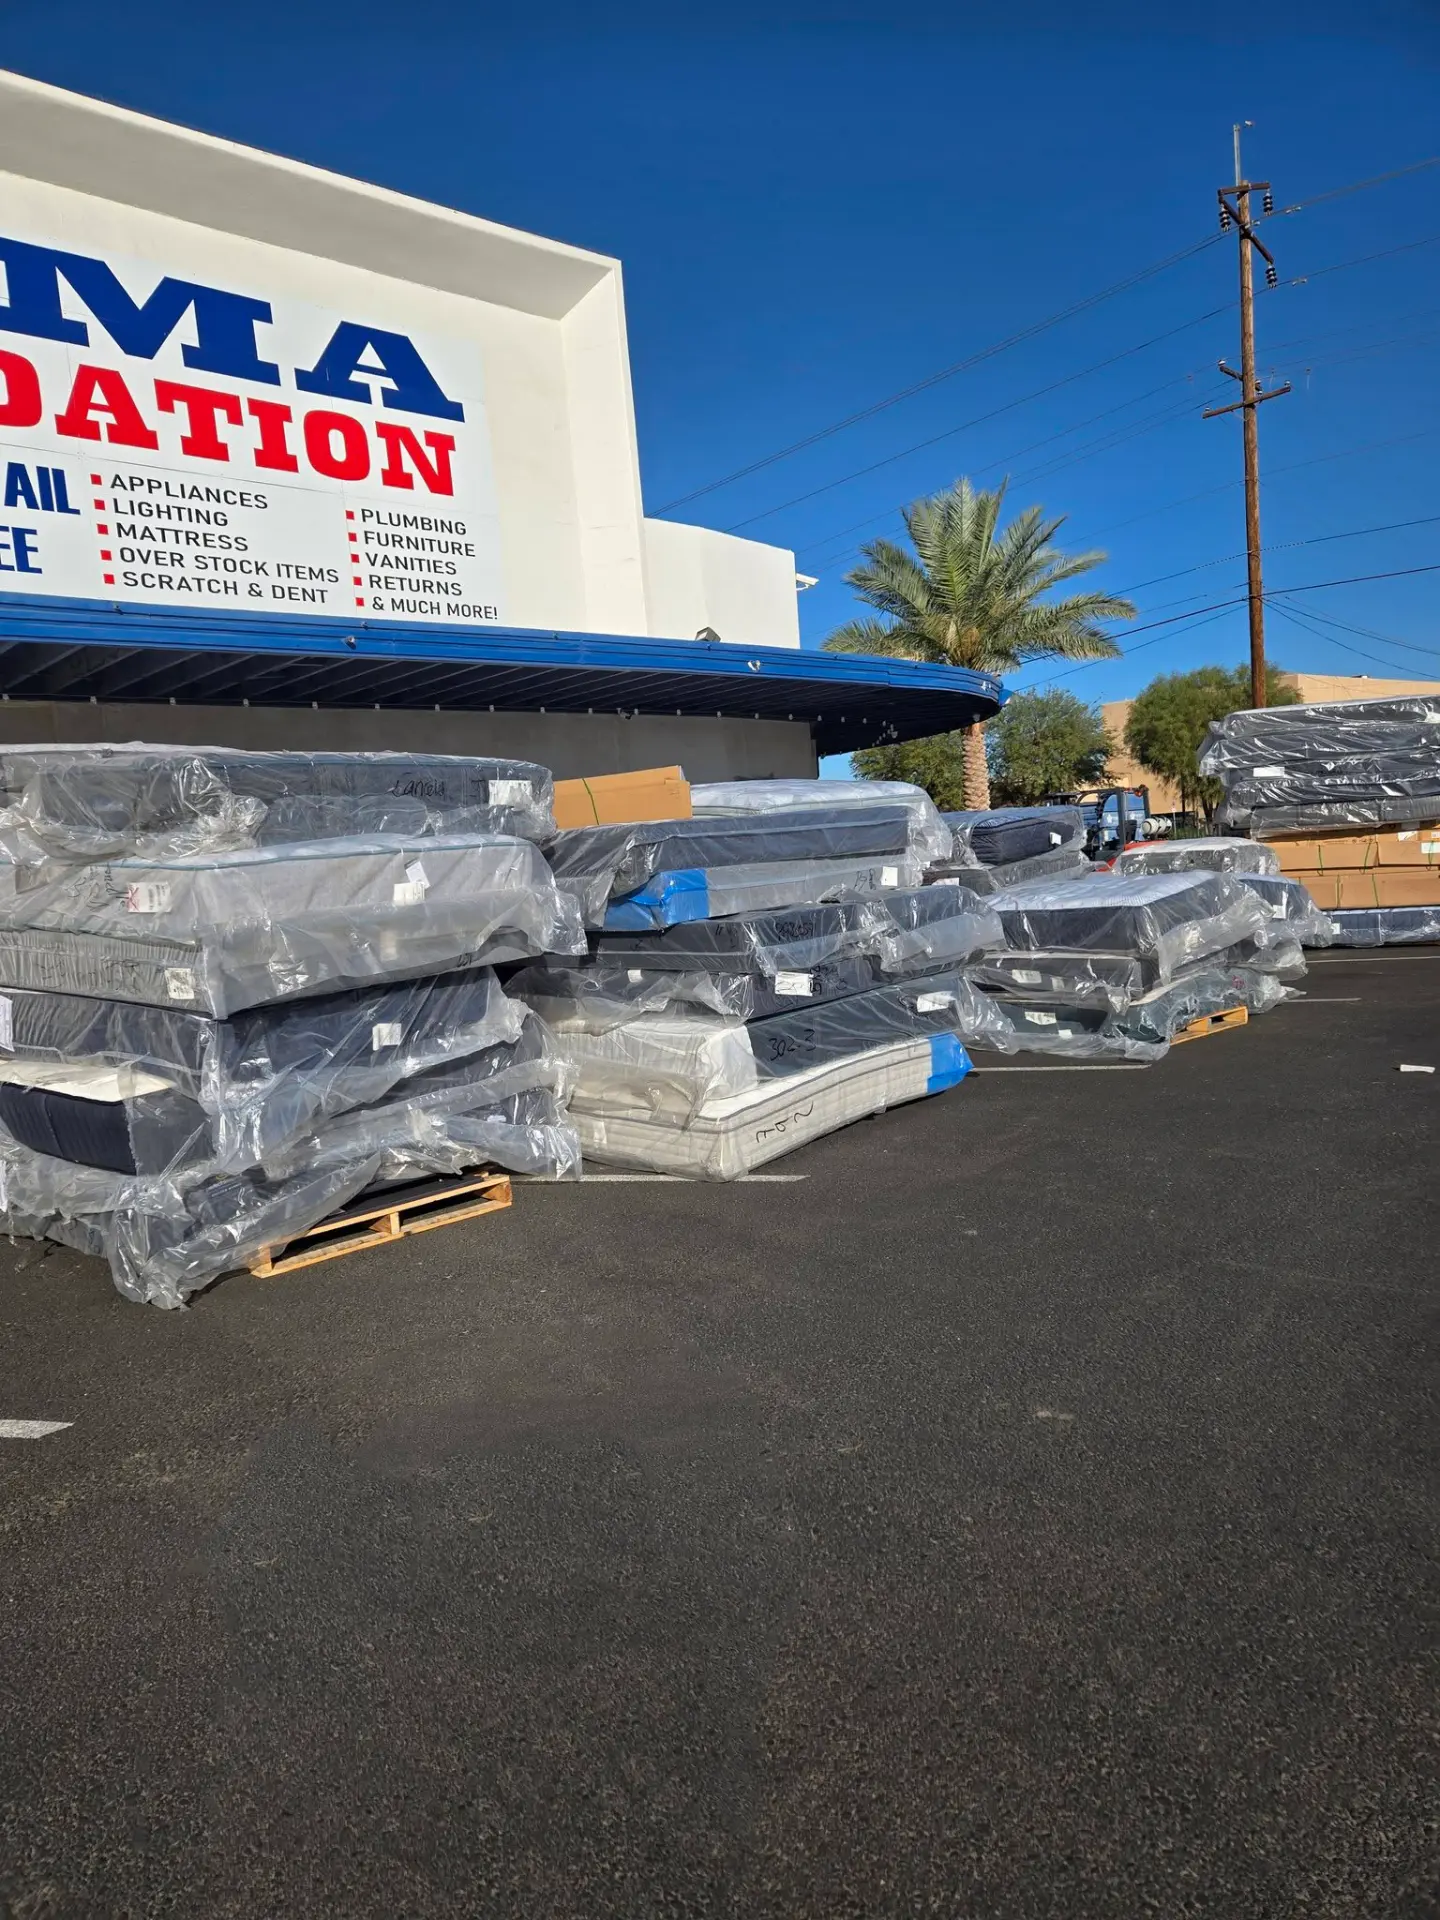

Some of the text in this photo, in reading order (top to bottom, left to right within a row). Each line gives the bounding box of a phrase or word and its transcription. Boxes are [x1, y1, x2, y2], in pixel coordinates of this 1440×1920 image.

[4, 462, 81, 515] AIL
[110, 474, 268, 509] APPLIANCES
[113, 498, 228, 527] LIGHTING
[361, 508, 467, 536] PLUMBING
[116, 522, 249, 552] MATTRESS
[364, 530, 476, 557] FURNITURE
[119, 547, 340, 584] OVER STOCK ITEMS
[365, 552, 457, 576] VANITIES
[122, 571, 329, 604] SCRATCH & DENT
[369, 574, 463, 597] RETURNS
[372, 596, 499, 620] & MUCH MORE!
